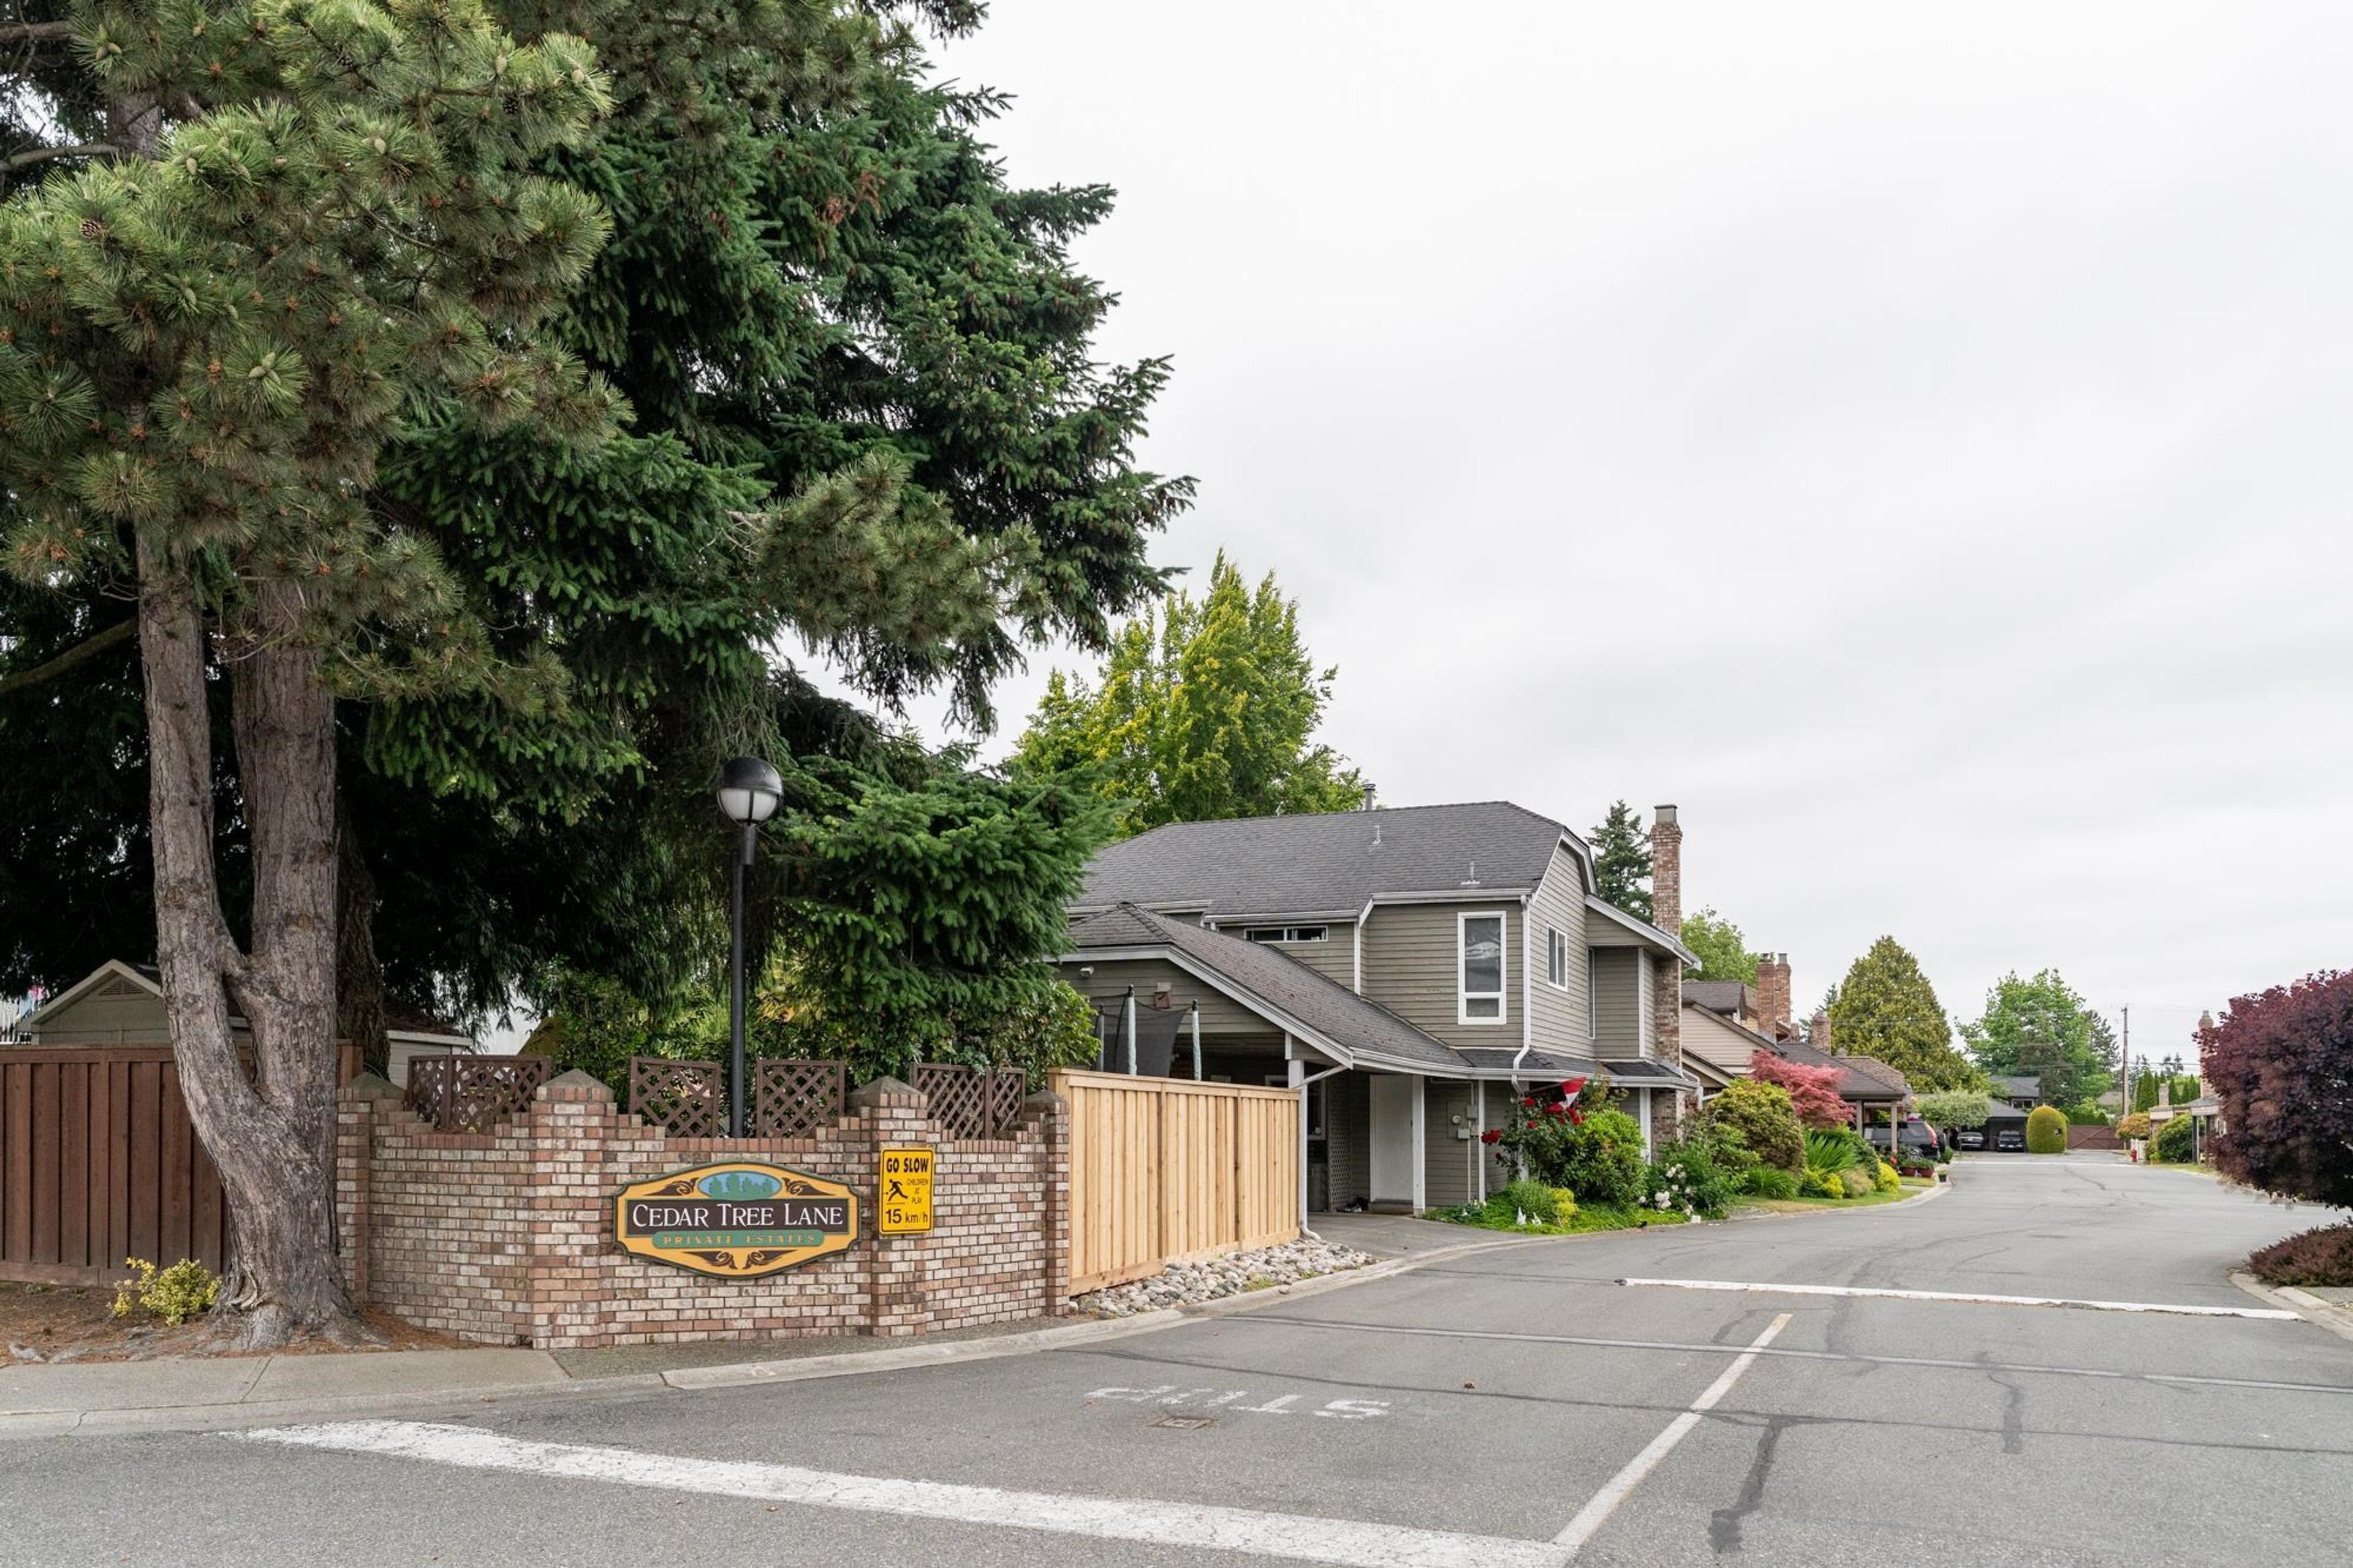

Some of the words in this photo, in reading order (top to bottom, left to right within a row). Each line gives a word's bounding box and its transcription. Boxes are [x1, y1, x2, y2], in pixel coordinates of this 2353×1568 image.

[887, 1157, 900, 1173] GO
[903, 1157, 929, 1173] SLOW
[632, 1204, 709, 1228] CEDAR
[716, 1203, 775, 1227] TREE
[784, 1203, 844, 1226] LANE
[885, 1209, 902, 1224] 15
[663, 1234, 733, 1245] PRIVATE
[746, 1234, 815, 1244] ESTATES
